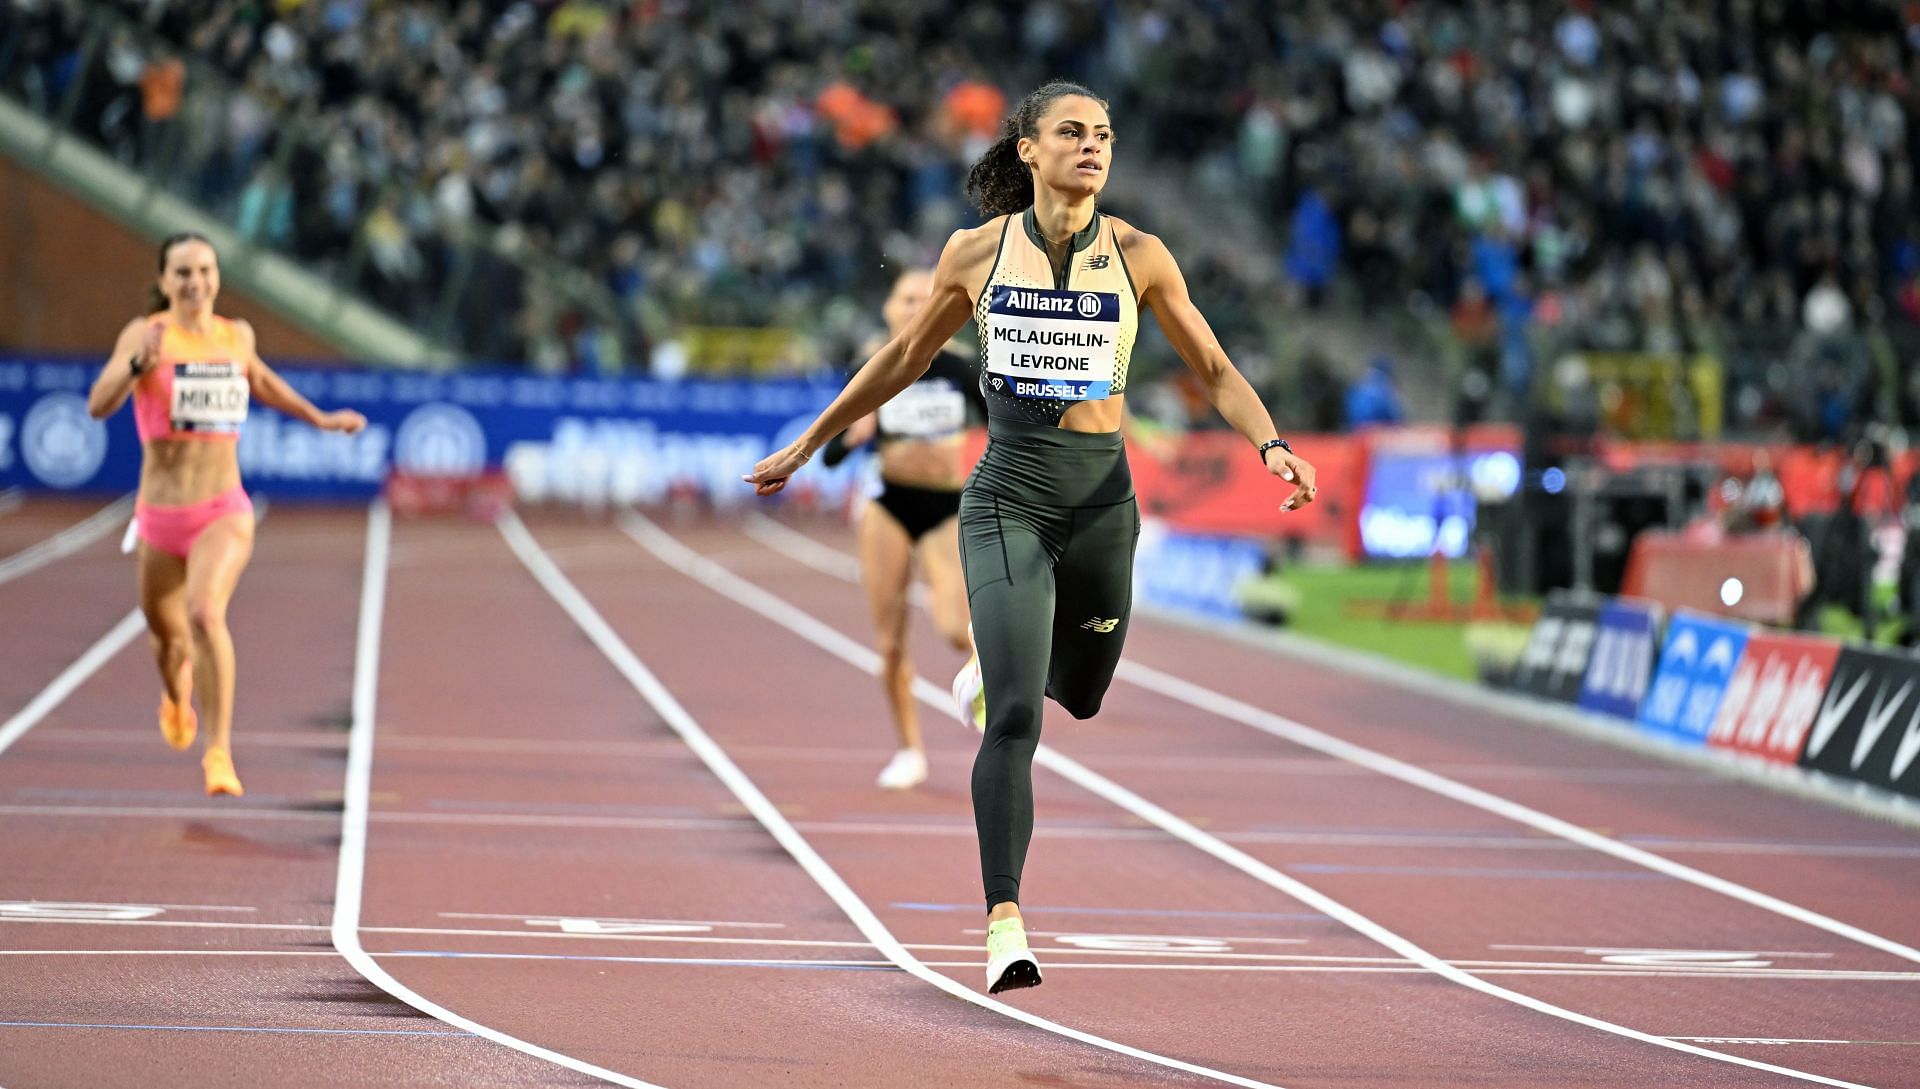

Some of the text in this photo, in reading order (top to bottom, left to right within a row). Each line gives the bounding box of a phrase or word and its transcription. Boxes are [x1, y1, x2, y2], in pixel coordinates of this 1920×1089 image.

[1006, 290, 1073, 312] Allianz
[994, 326, 1110, 347] MCLAUGHLIN-
[1010, 353, 1090, 371] LEVRONE
[178, 386, 248, 412] MIKLÓ
[1016, 382, 1088, 398] BRUSSELS
